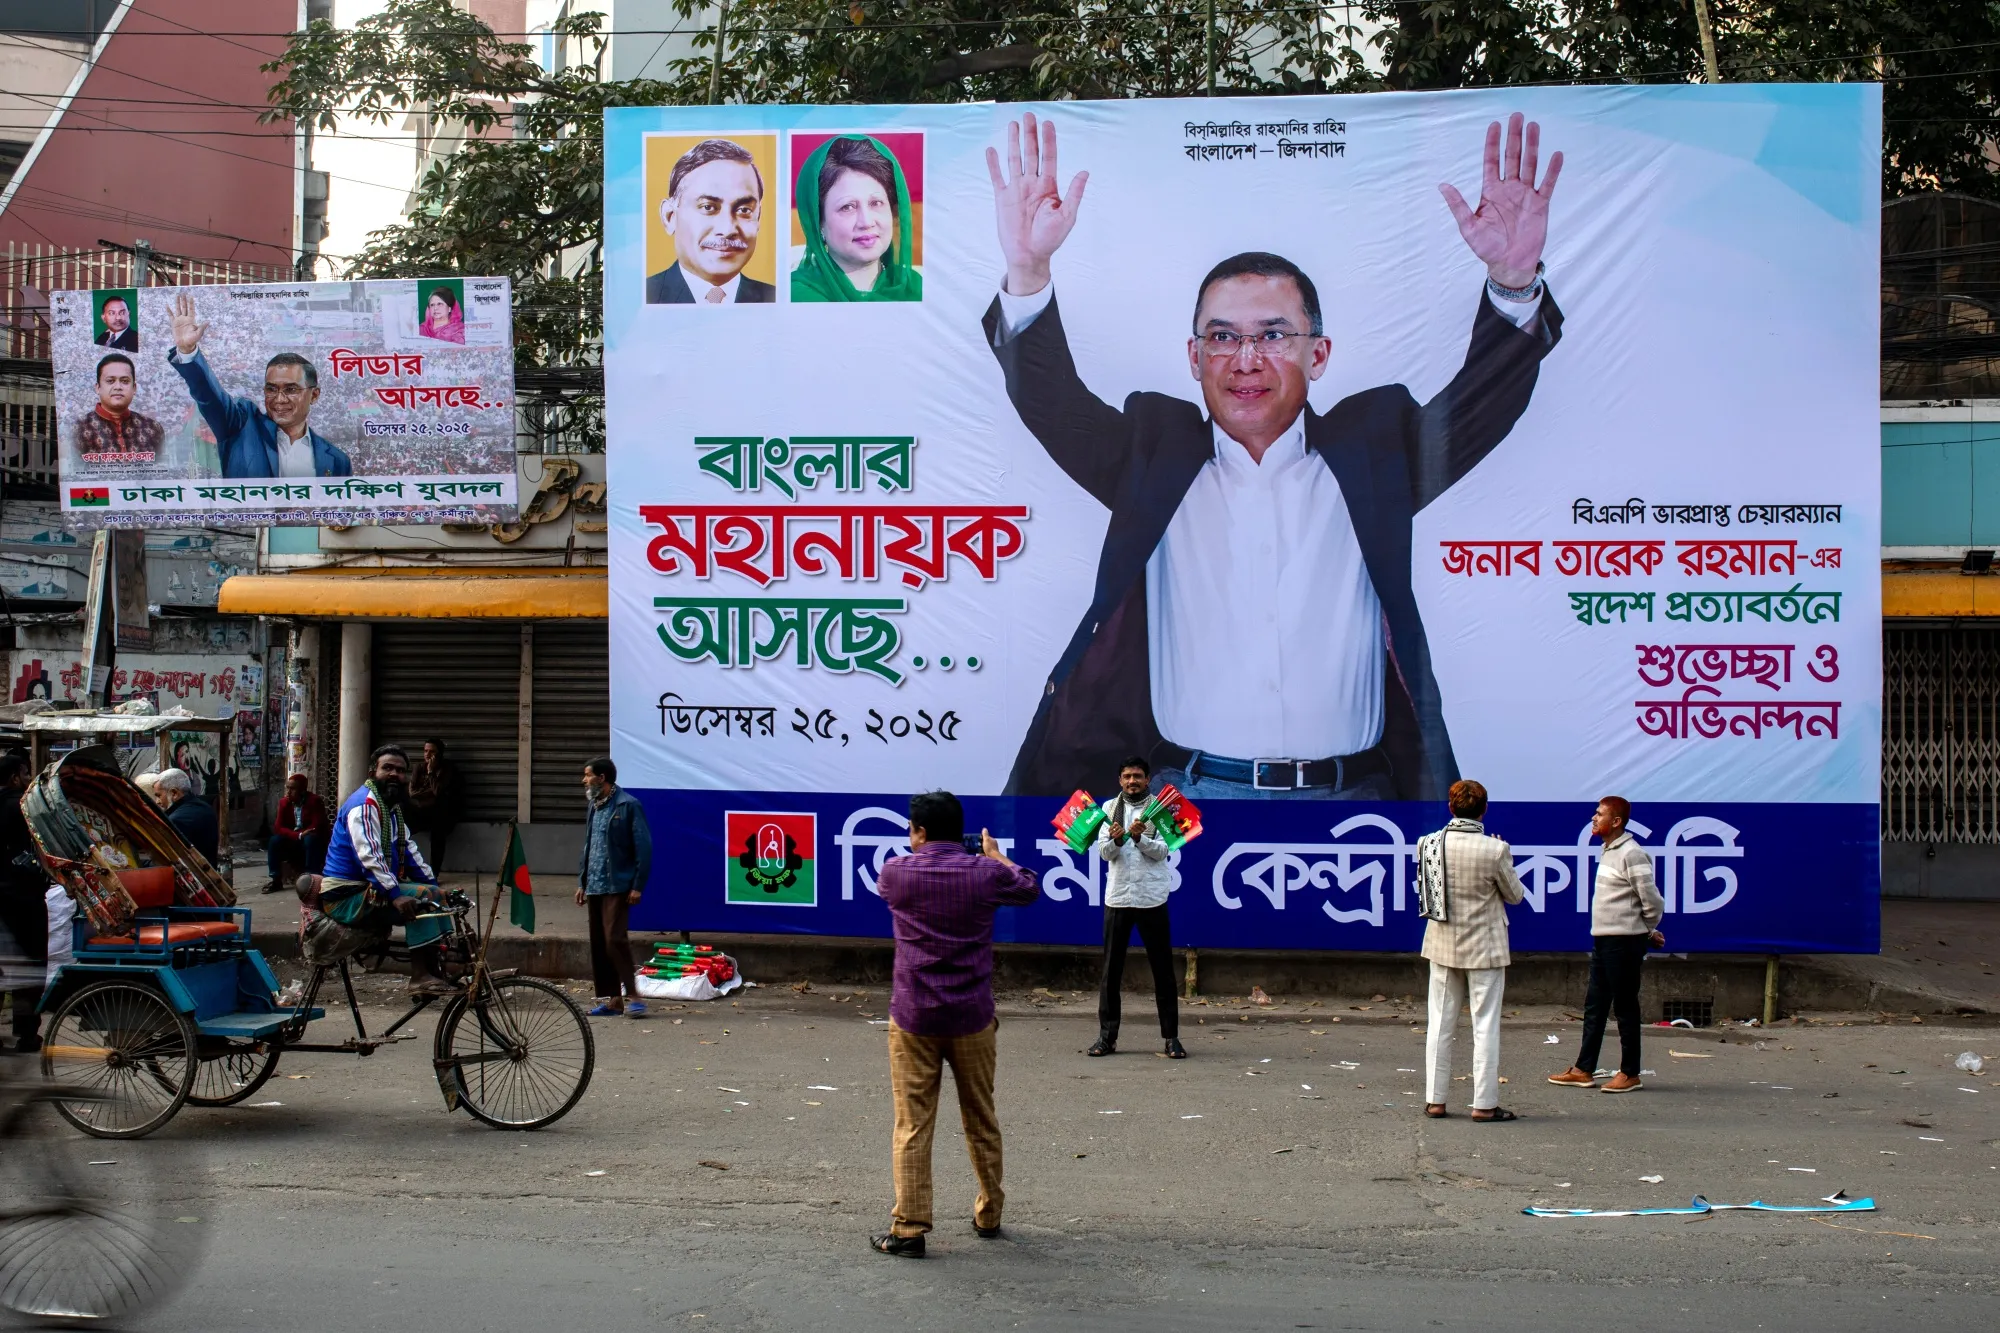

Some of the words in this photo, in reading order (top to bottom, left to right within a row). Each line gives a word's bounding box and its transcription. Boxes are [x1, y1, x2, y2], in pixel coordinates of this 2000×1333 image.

[1312, 117, 1347, 136] রাহিম
[1184, 143, 1257, 162] বাংলাদেশ
[1277, 137, 1347, 159] জিন্দাবাদ
[327, 348, 425, 379] লিডার
[364, 420, 406, 436] ডিসেম্বর
[410, 423, 432, 436] ২৫,
[436, 422, 471, 436] ২০২৫
[694, 436, 915, 499] বাংলার
[118, 485, 186, 503] ঢাকা
[194, 483, 312, 503] মহানগর
[321, 478, 405, 500] দক্ষিণ
[414, 481, 504, 502] যুবদল
[103, 513, 132, 524] প্রচারে
[142, 513, 164, 523] ঢাকা
[167, 512, 205, 523] মহানগর
[207, 511, 235, 523] দক্ষিণ
[237, 512, 277, 524] যুবদলের
[355, 510, 376, 520] এবং
[1572, 498, 1645, 524] বিএনপি
[1652, 504, 1732, 527] ভারপ্রাপ্ত
[1737, 503, 1842, 526] চেয়ারম্যান
[639, 505, 1027, 588] মহানায়ক
[1440, 541, 1543, 578] জনাব
[1553, 540, 1665, 578] তারেক
[1568, 592, 1655, 626] স্বদেশ
[1664, 583, 1842, 624] প্রত্যাবর্তনে
[1635, 644, 1795, 692] শুভেচ্ছা
[1806, 644, 1840, 683] ও
[656, 692, 777, 738] ডিসেম্বর
[791, 707, 849, 746] ২৫,
[865, 707, 962, 745] ২০২৫
[1635, 685, 1842, 741] অভিনন্দন
